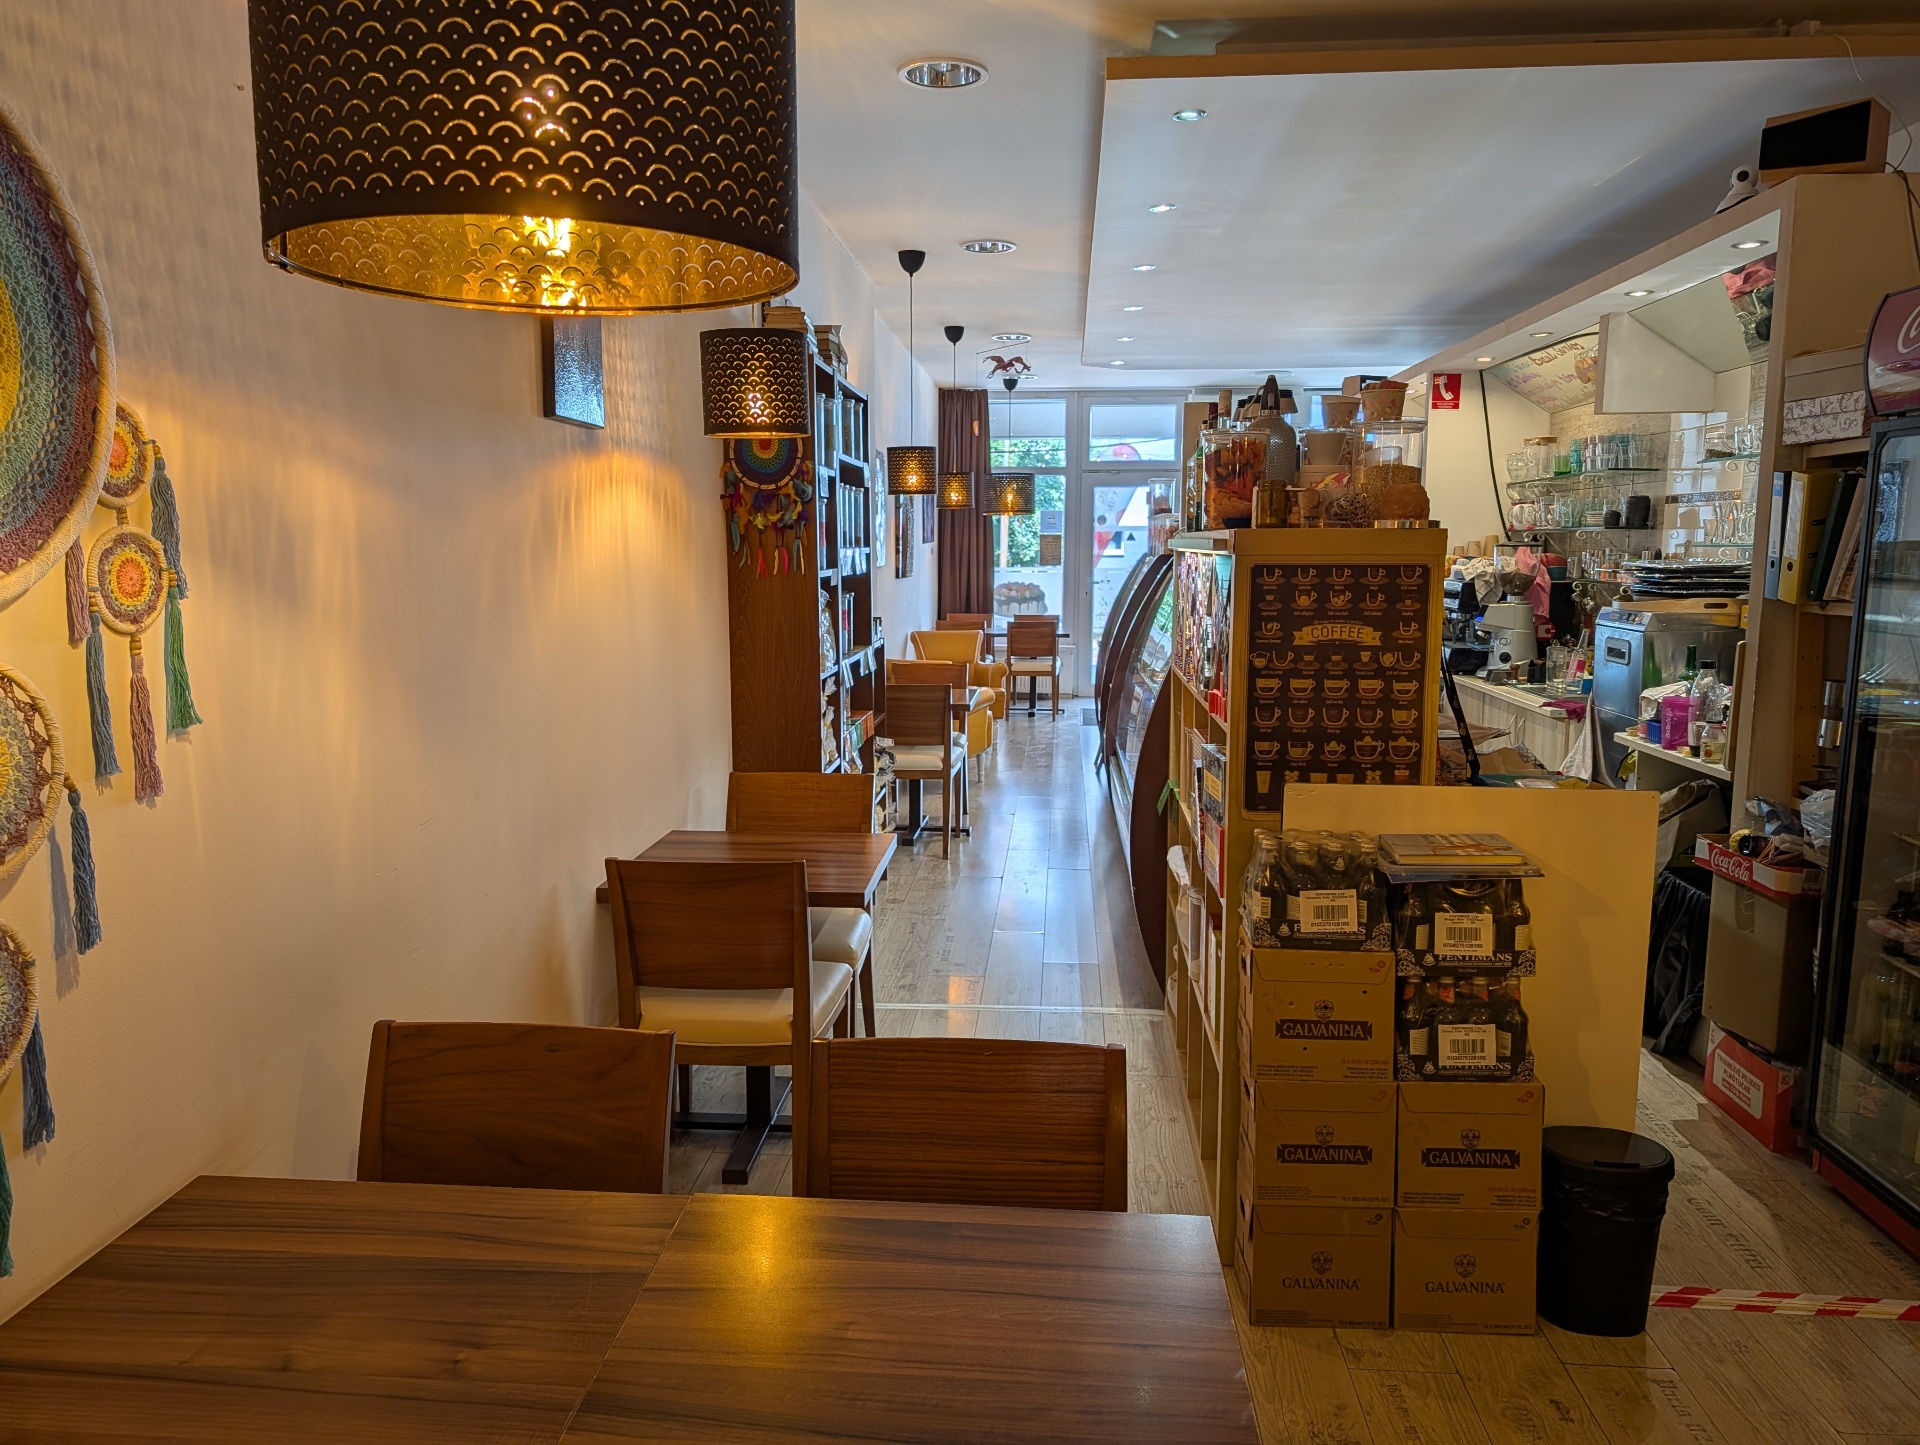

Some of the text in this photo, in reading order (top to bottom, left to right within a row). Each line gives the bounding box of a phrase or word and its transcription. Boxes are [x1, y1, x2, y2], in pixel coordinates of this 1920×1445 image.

[1311, 626, 1365, 639] COFFEE
[1283, 1022, 1364, 1038] GALVANINA
[1284, 1147, 1364, 1162] GALVANINA
[1429, 1151, 1512, 1166] GALVANINA
[1282, 1277, 1360, 1290] GALVANINA
[1425, 1281, 1505, 1294] GALVANINA
